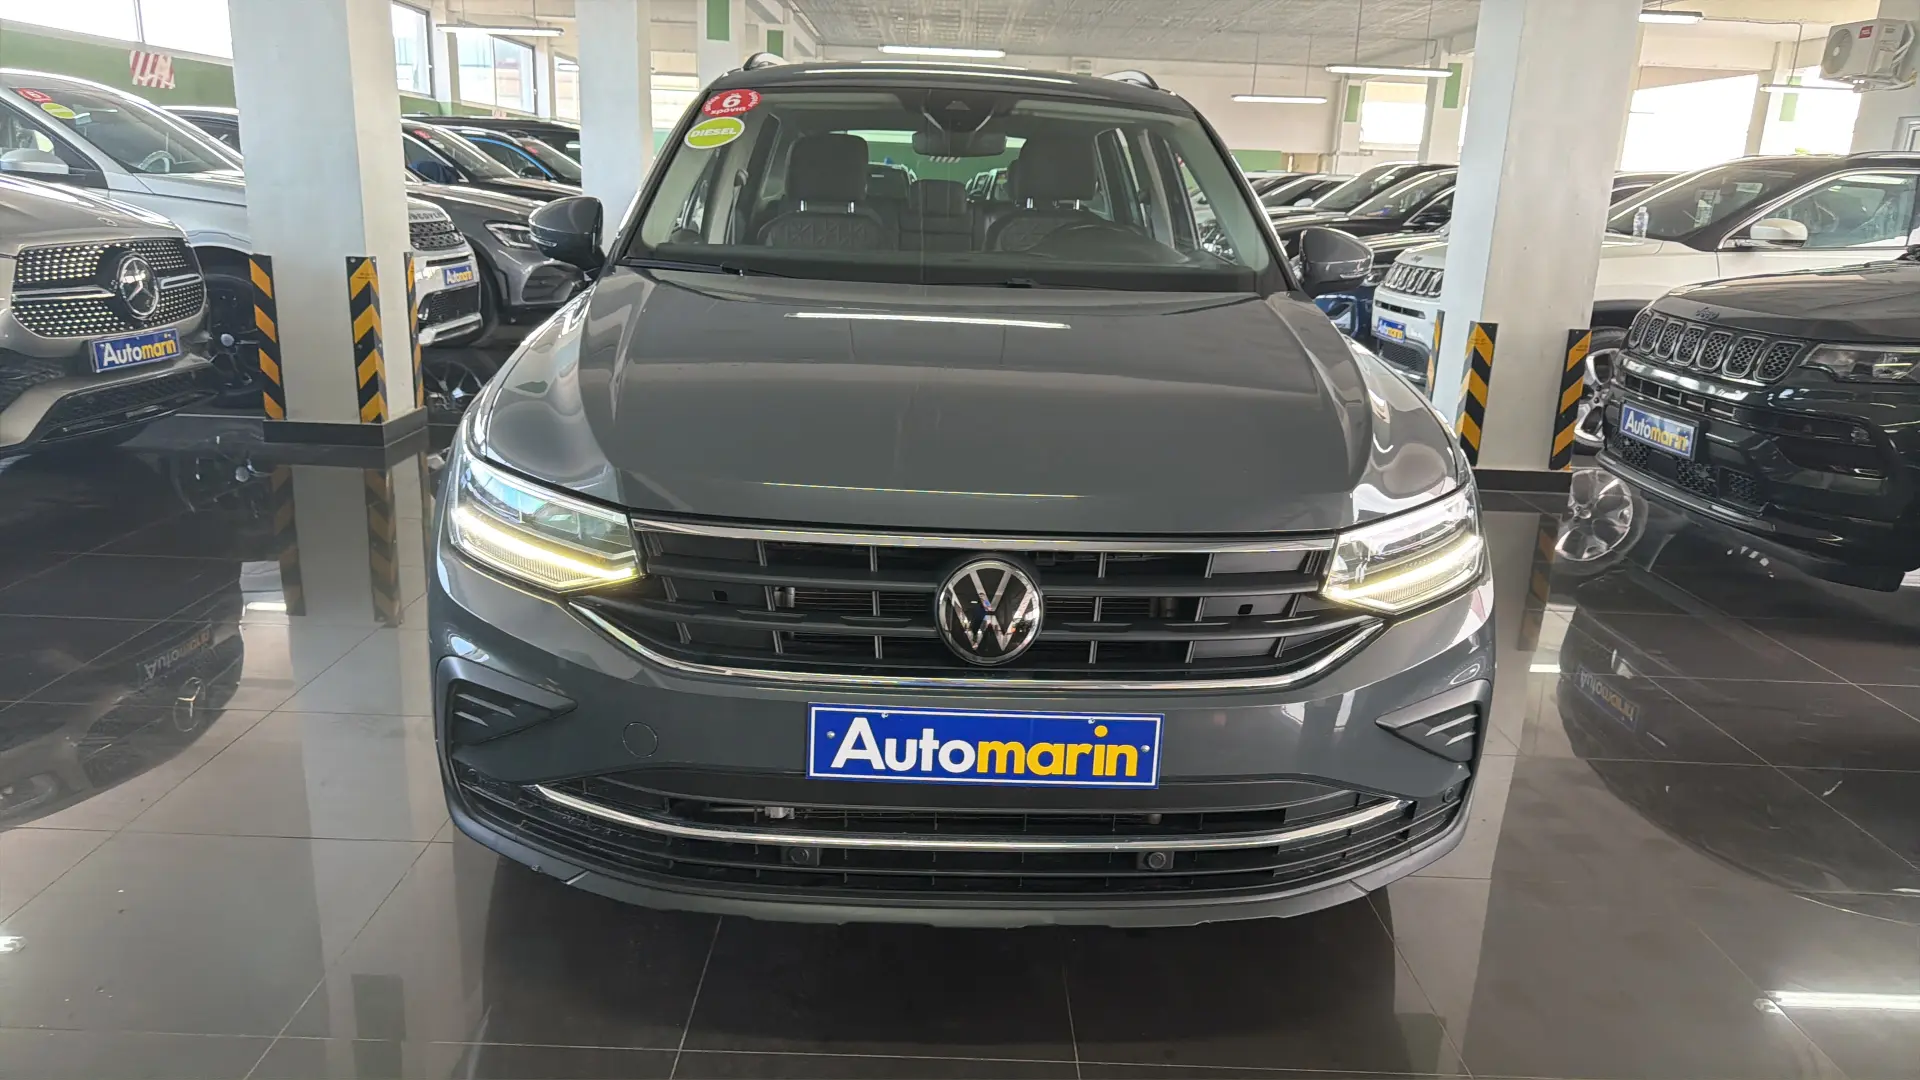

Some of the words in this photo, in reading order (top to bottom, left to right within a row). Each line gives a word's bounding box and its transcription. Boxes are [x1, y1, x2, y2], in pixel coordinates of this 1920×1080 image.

[722, 94, 742, 108] 6
[690, 127, 737, 138] DIESEL
[103, 333, 176, 367] Automarin
[1624, 410, 1689, 452] Automarin
[831, 717, 1139, 777] Automarin
